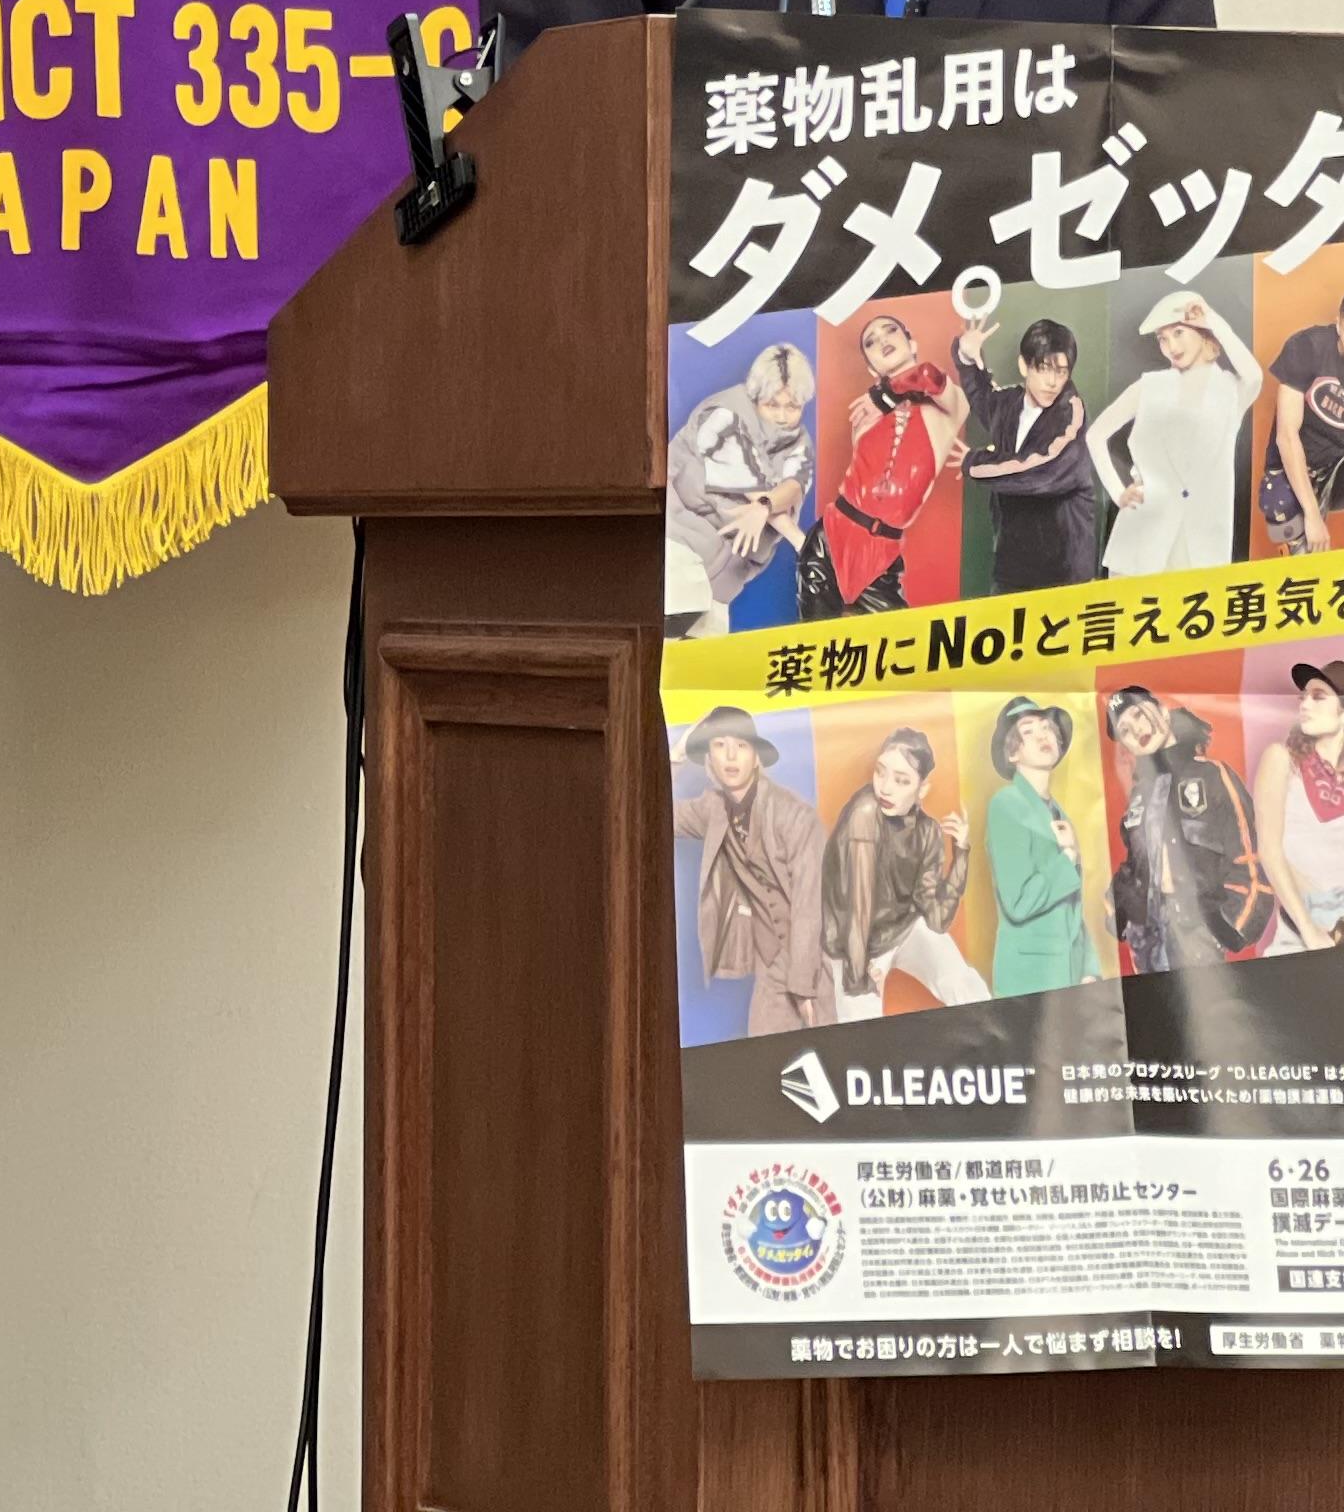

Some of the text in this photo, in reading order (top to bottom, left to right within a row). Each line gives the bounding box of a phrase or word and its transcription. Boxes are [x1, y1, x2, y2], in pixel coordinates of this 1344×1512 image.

[703, 43, 1078, 157] 薬物乱用は
[1062, 1063, 1221, 1080] 日本発のプロダンスリーグ
[847, 1068, 1027, 1106] D.LEAGUE
[1222, 1332, 1304, 1350] 厚生労働省
